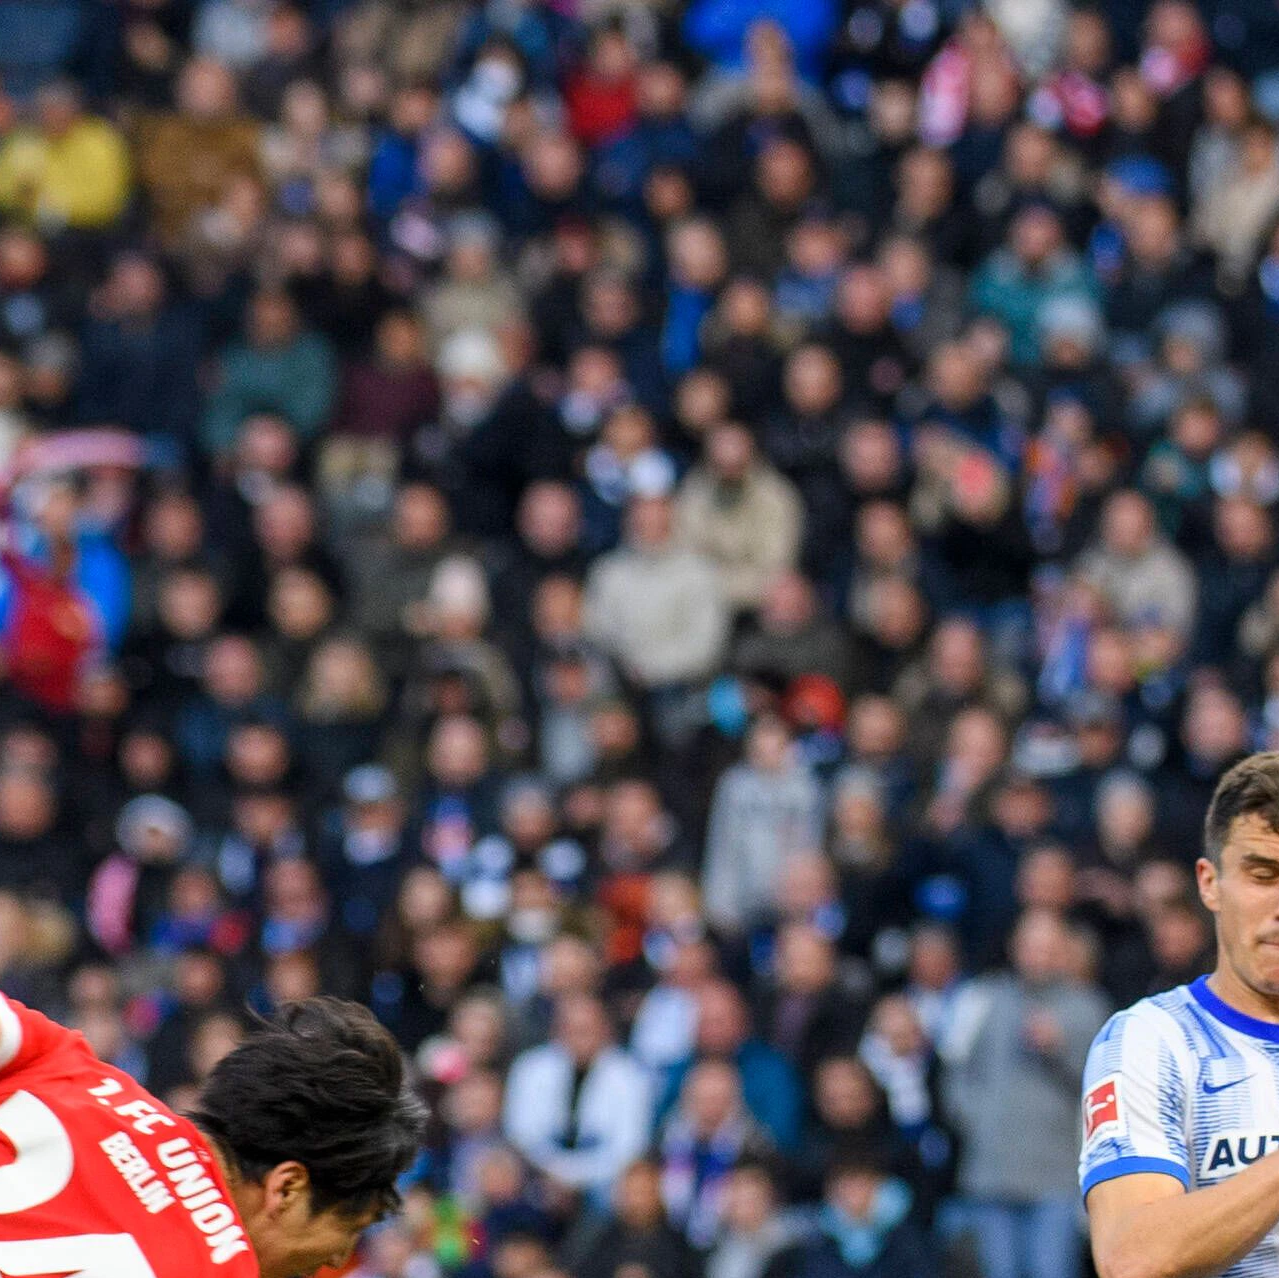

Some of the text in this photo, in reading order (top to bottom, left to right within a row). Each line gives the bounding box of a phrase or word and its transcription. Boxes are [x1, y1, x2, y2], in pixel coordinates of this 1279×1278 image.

[87, 1077, 250, 1265] 1. FC UNION
[98, 1130, 176, 1215] BERLIN
